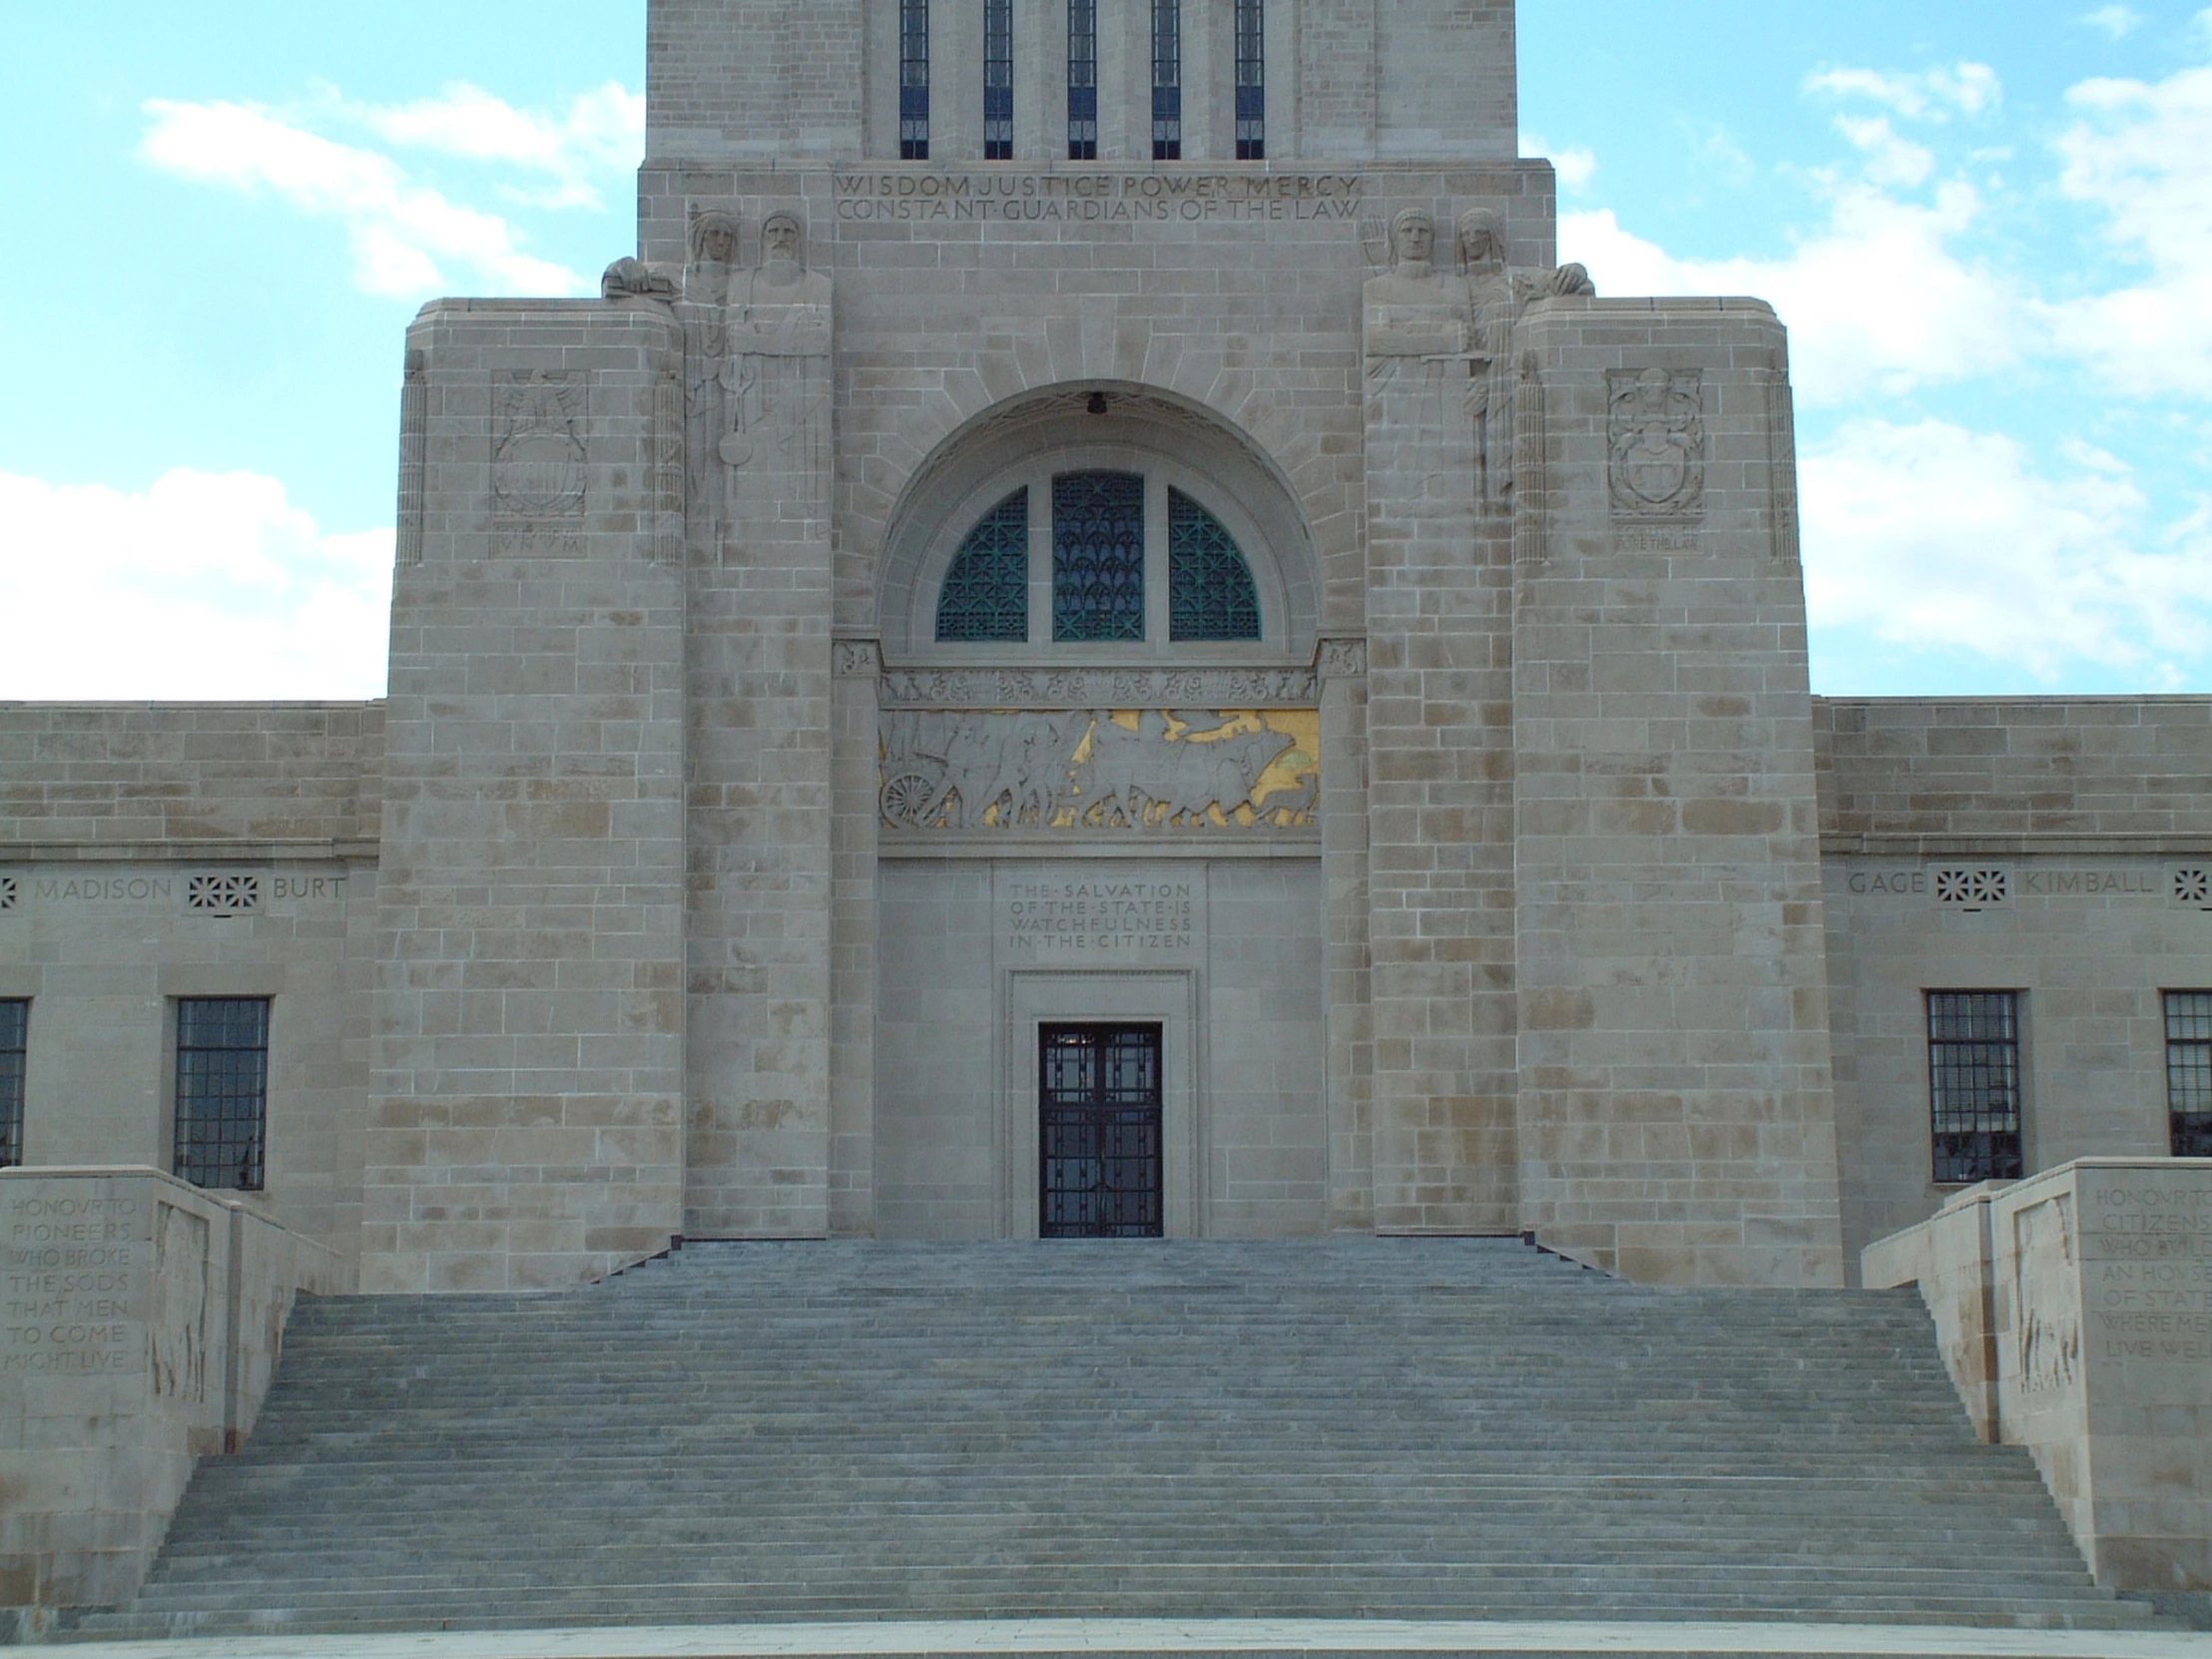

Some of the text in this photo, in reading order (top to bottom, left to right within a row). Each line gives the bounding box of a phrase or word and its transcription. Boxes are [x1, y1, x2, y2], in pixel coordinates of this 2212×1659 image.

[835, 176, 1359, 198] WISDOM JUSTICE POWER MERCY
[837, 200, 1361, 221] CONSTANT GUARDIANS OF THE LAW
[35, 878, 172, 899] MADISON
[274, 877, 347, 899] BURT
[1010, 884, 1191, 897] THE SALVATION
[1849, 871, 1926, 894] GAGE
[2025, 870, 2153, 893] KIMBALL
[1010, 901, 1191, 915] OF THE STATE IS
[1010, 918, 1191, 932] WATCHFULNESS
[1009, 935, 1191, 949] IN THE CITIZEN
[108, 1198, 137, 1216] TO
[12, 1223, 132, 1242] PIONEERS
[2102, 1214, 2210, 1232] CITIZENS
[2099, 1239, 2150, 1257] WHO
[9, 1249, 131, 1268] WHO BROKE
[9, 1274, 130, 1293] THE SODS
[2101, 1265, 2133, 1283] AN
[2103, 1289, 2212, 1308] OF STATE
[6, 1300, 128, 1319] THAT MEN
[2100, 1315, 2212, 1334] WHERE ME
[6, 1325, 126, 1345] TO COME
[2105, 1340, 2212, 1359] LIVE WEL
[4, 1351, 126, 1371] MIGHT LIVE
